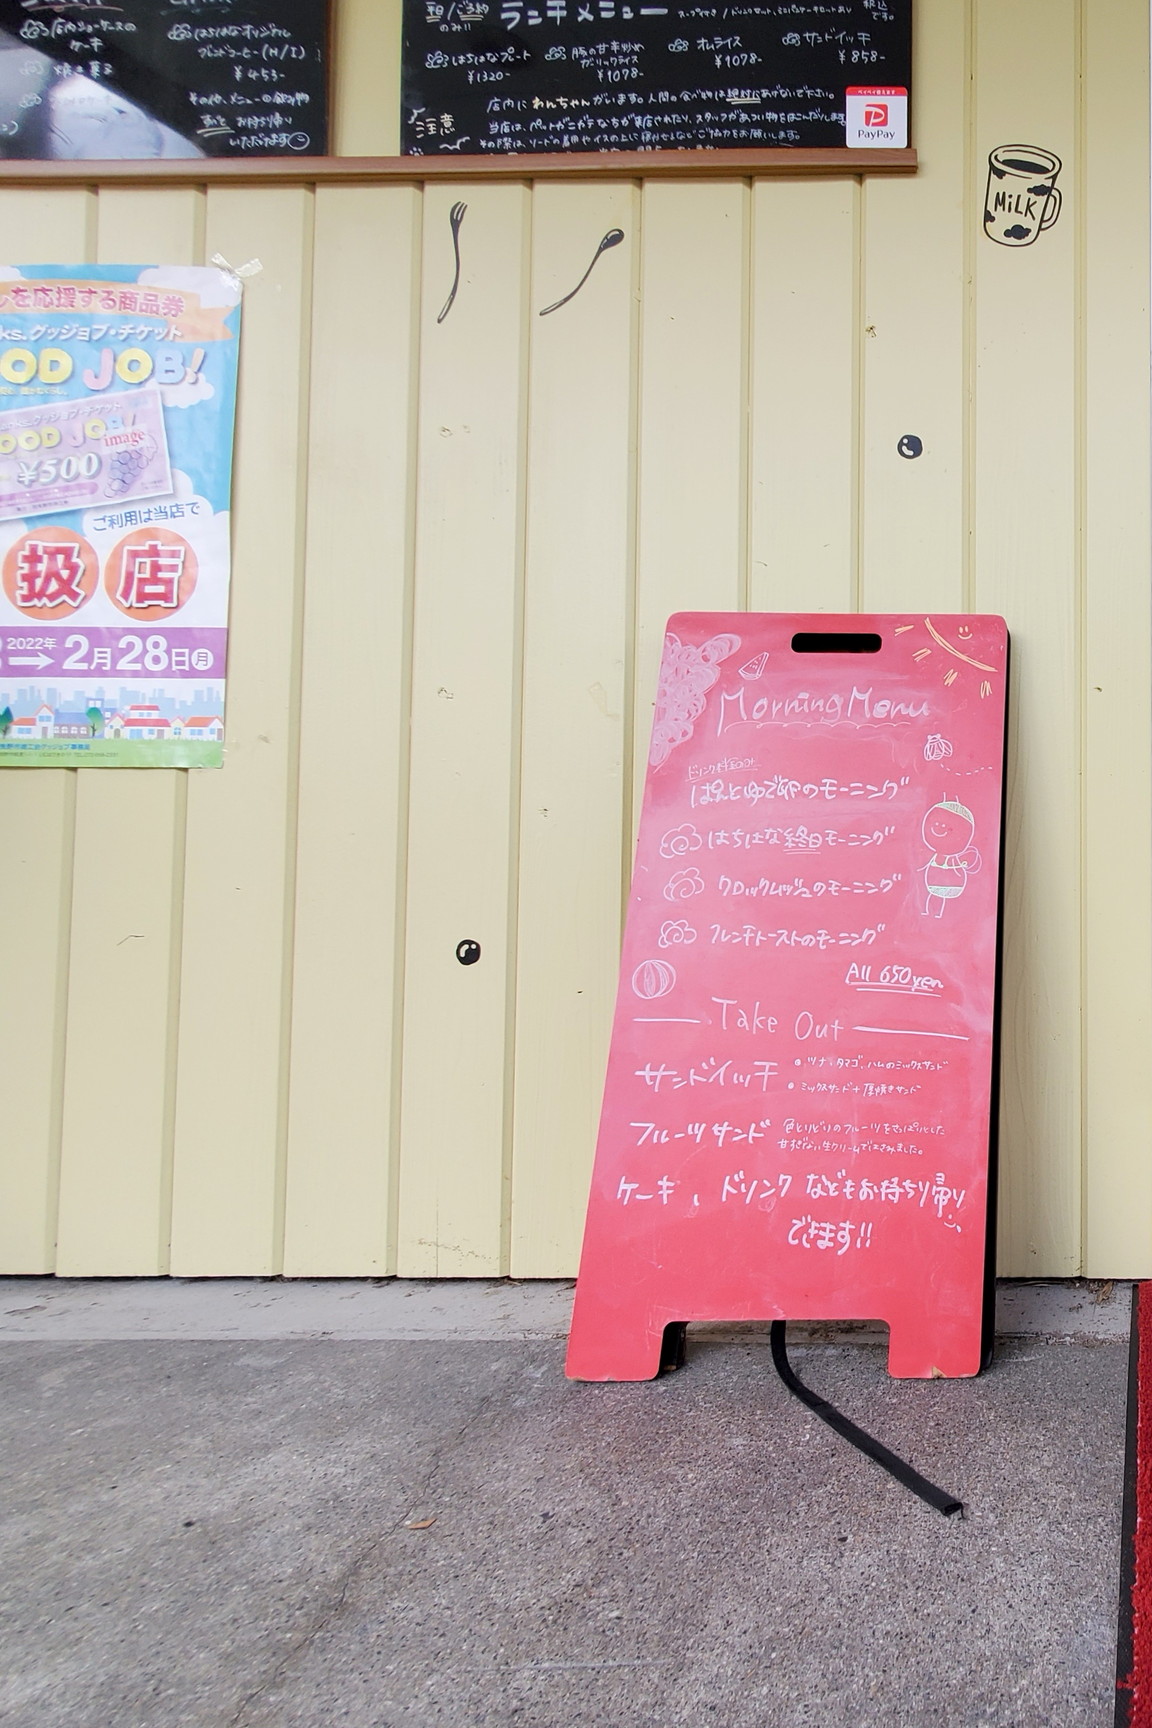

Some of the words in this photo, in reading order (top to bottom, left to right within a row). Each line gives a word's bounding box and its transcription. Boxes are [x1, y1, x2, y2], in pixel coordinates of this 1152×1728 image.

[500, 1, 668, 30] ランチメニュー
[70, 37, 103, 52] ケーキ
[697, 36, 742, 51] オムライス
[803, 27, 871, 47] サンドイッチ
[415, 113, 455, 138] 注意
[858, 130, 895, 140] PayPay
[994, 191, 1037, 221] MiLK
[82, 348, 206, 391] JOB!
[104, 429, 146, 448] image
[17, 452, 102, 487] ¥500
[92, 501, 200, 531] ご利用は当店で
[7, 637, 57, 650] 2022年
[717, 686, 842, 737] Morning
[847, 686, 930, 720] Menu
[710, 923, 886, 949] フレンチトーストのモーニング
[845, 962, 872, 985] All
[711, 996, 778, 1035] Take
[794, 1011, 844, 1040] Out
[634, 1056, 779, 1092] サンドイッチ
[630, 1119, 771, 1147] フルーツサンド
